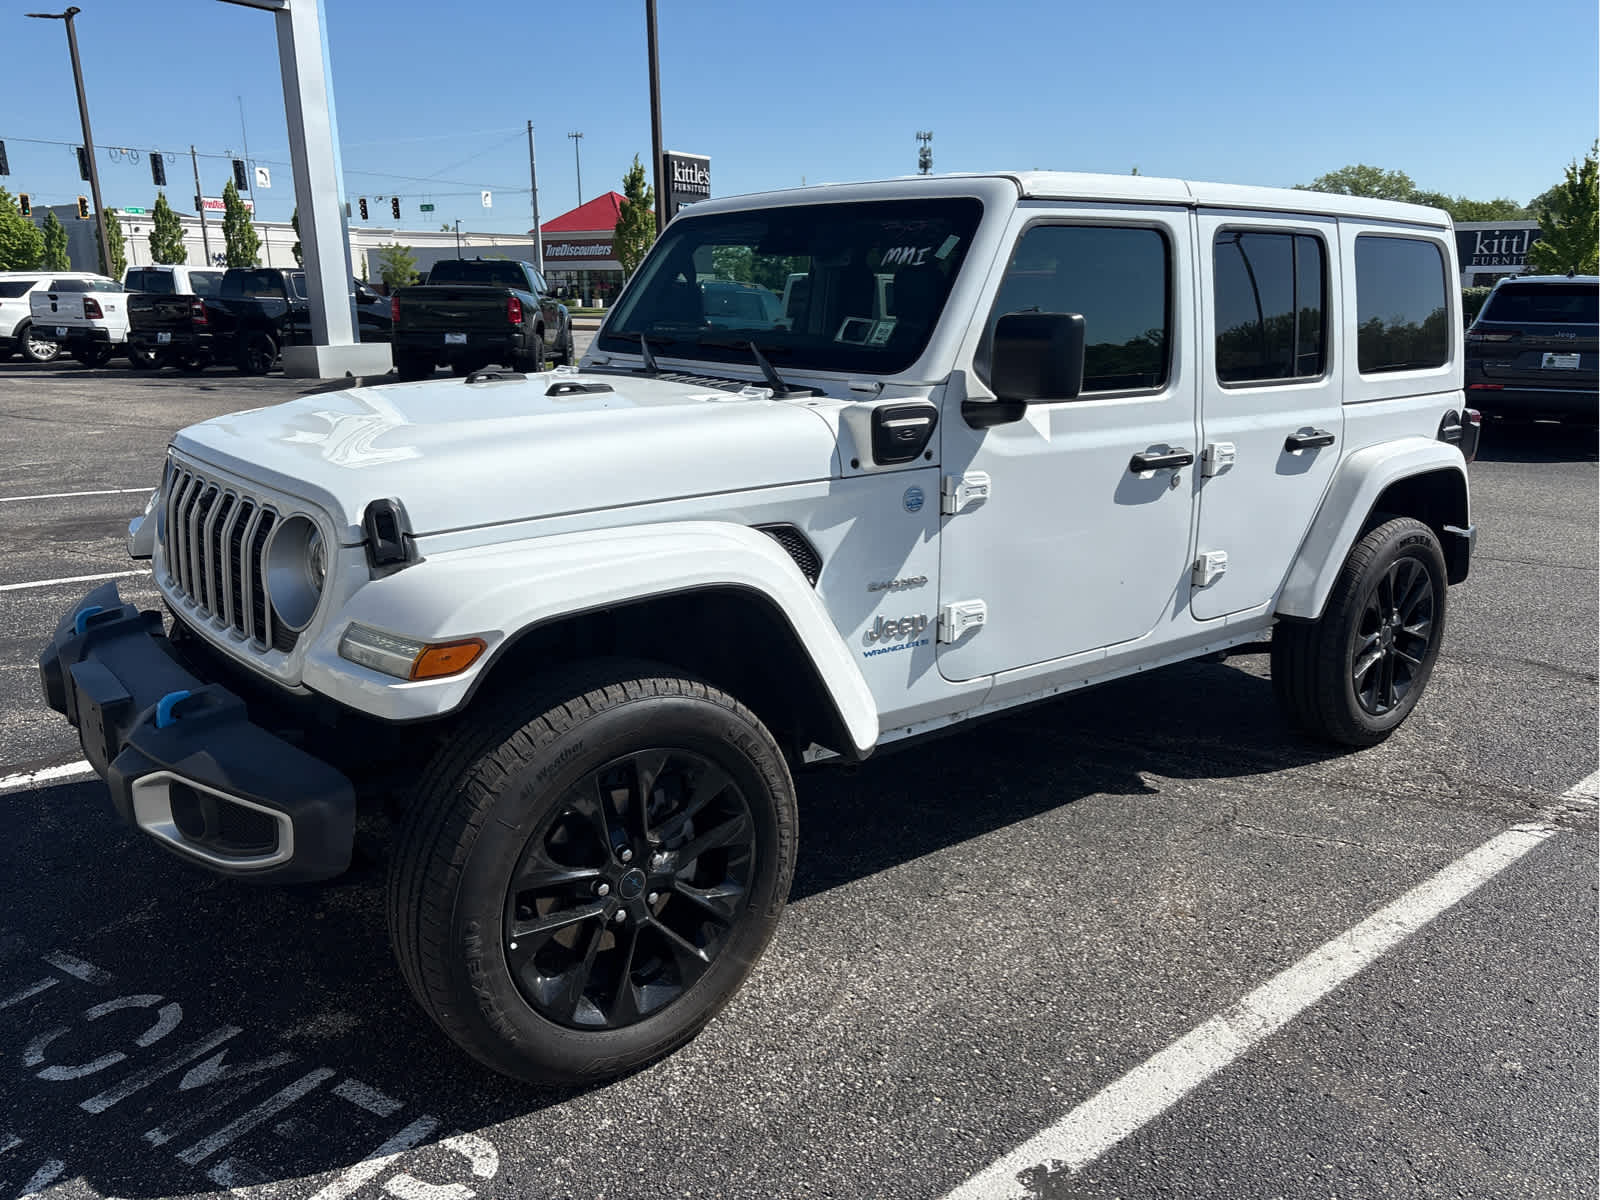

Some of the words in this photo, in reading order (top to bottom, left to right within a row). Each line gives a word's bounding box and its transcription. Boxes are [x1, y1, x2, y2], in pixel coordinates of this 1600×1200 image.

[673, 161, 710, 185] kittle's
[674, 183, 710, 194] FURNITURE
[545, 244, 613, 257] TireDiscounters
[1472, 230, 1530, 255] kittl
[1472, 256, 1528, 265] FURNIT
[865, 614, 928, 642] Jeep
[863, 641, 919, 657] WRANGLER
